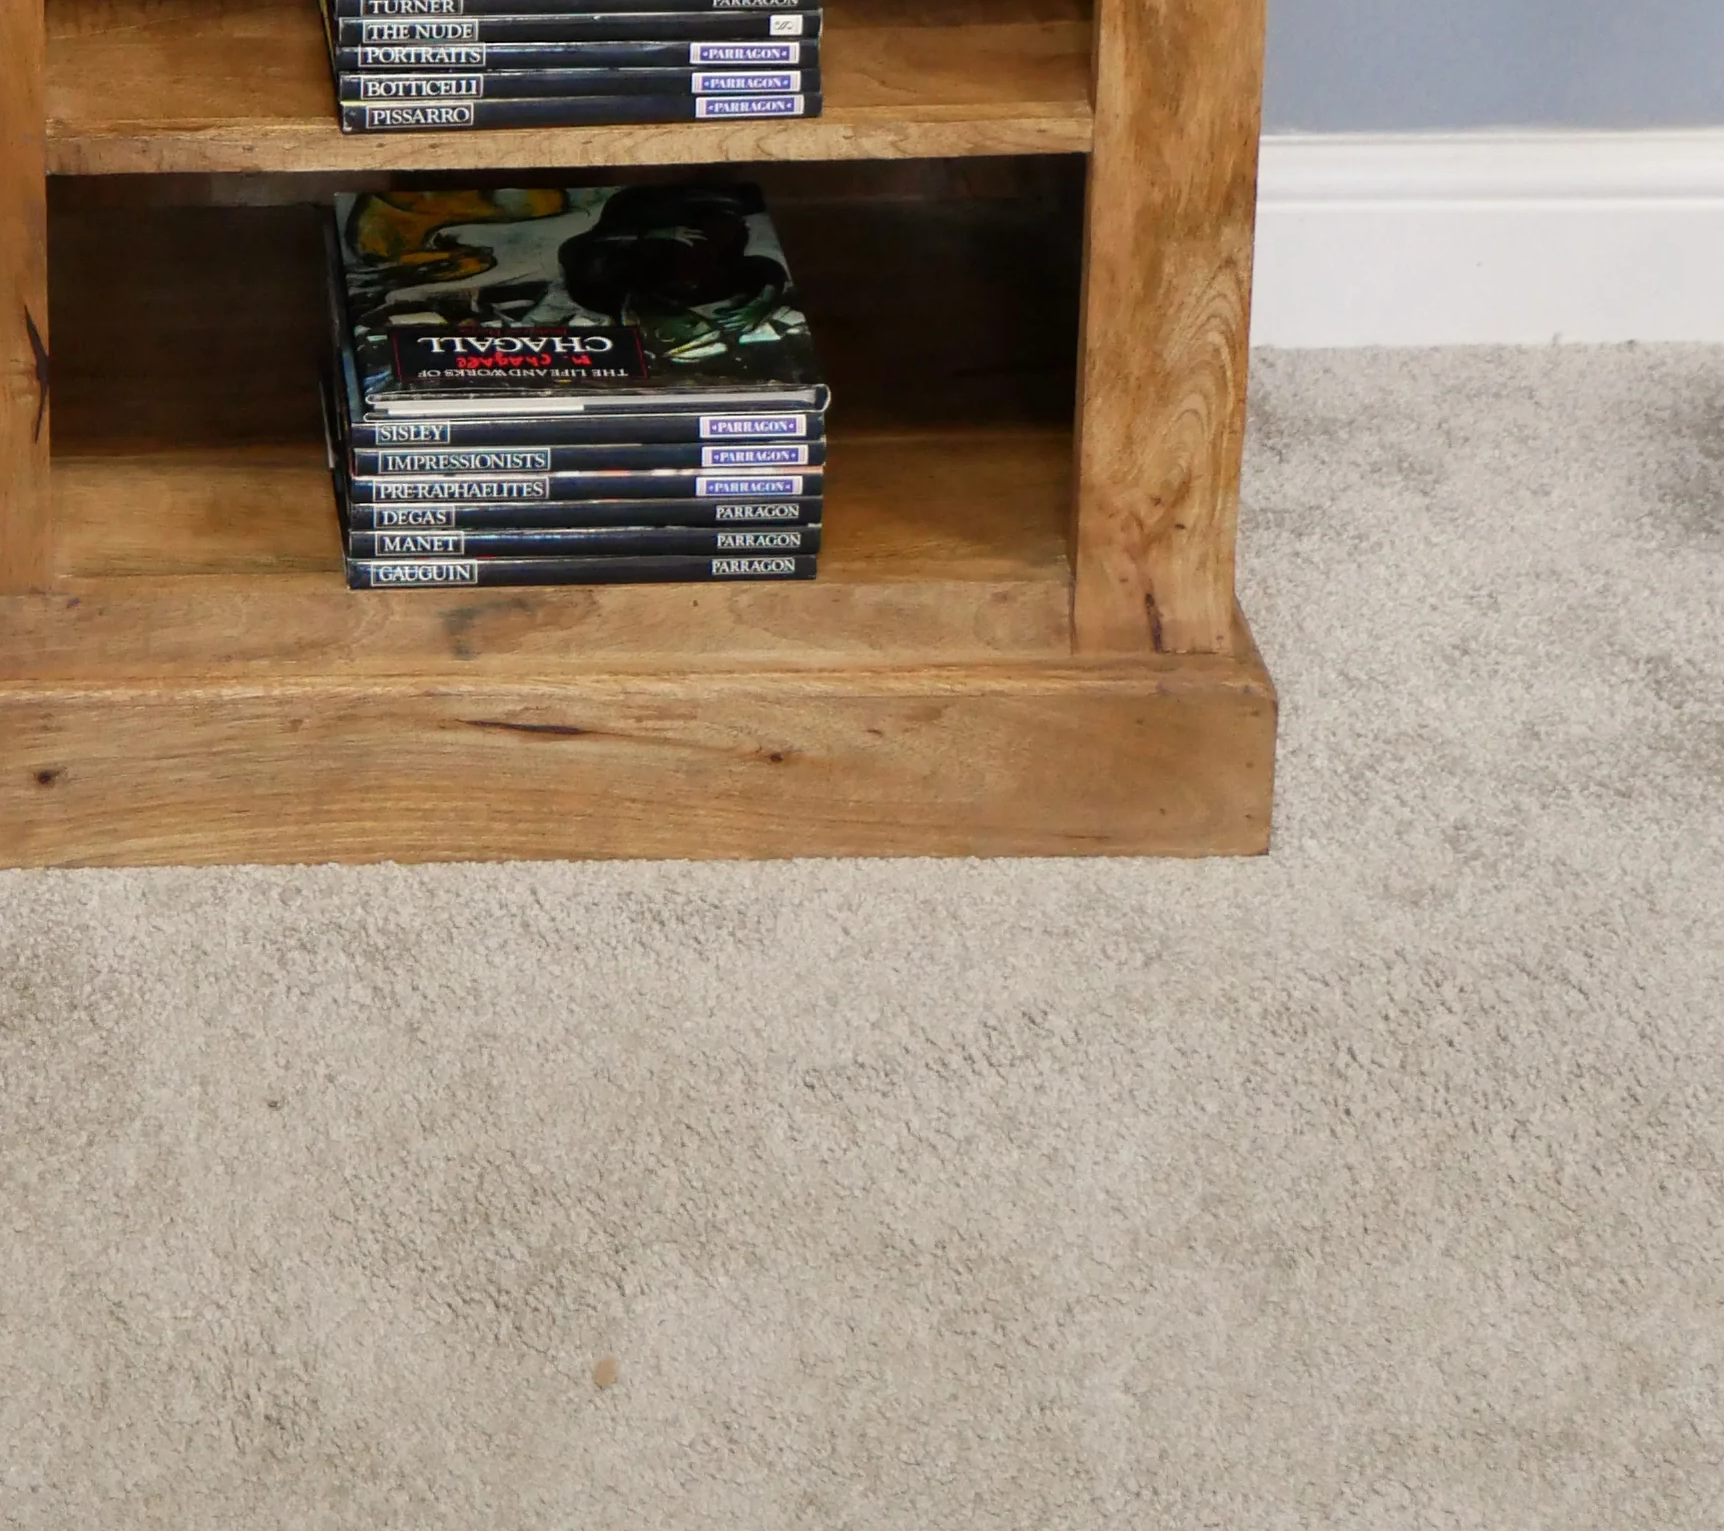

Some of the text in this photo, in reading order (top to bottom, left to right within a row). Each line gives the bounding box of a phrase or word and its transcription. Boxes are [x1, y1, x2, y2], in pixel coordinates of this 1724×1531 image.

[367, 23, 474, 41] THE NUDE
[366, 47, 481, 65] PORTRAITS
[367, 79, 477, 97] BOTTICELLI
[372, 108, 470, 125] PISSARRO
[416, 336, 614, 353] CHAGALL
[417, 368, 628, 378] THE LIFE AND WORKS OF
[380, 425, 445, 442] SISLEY
[386, 453, 546, 471] IMPRESSIONISTS
[382, 510, 446, 526] DEGAS
[716, 504, 799, 519] PARRAGON
[384, 537, 457, 553] MANET
[717, 533, 801, 548] PARRAGON
[379, 565, 471, 582] GAUGUIN
[712, 558, 795, 574] PARRAGON
